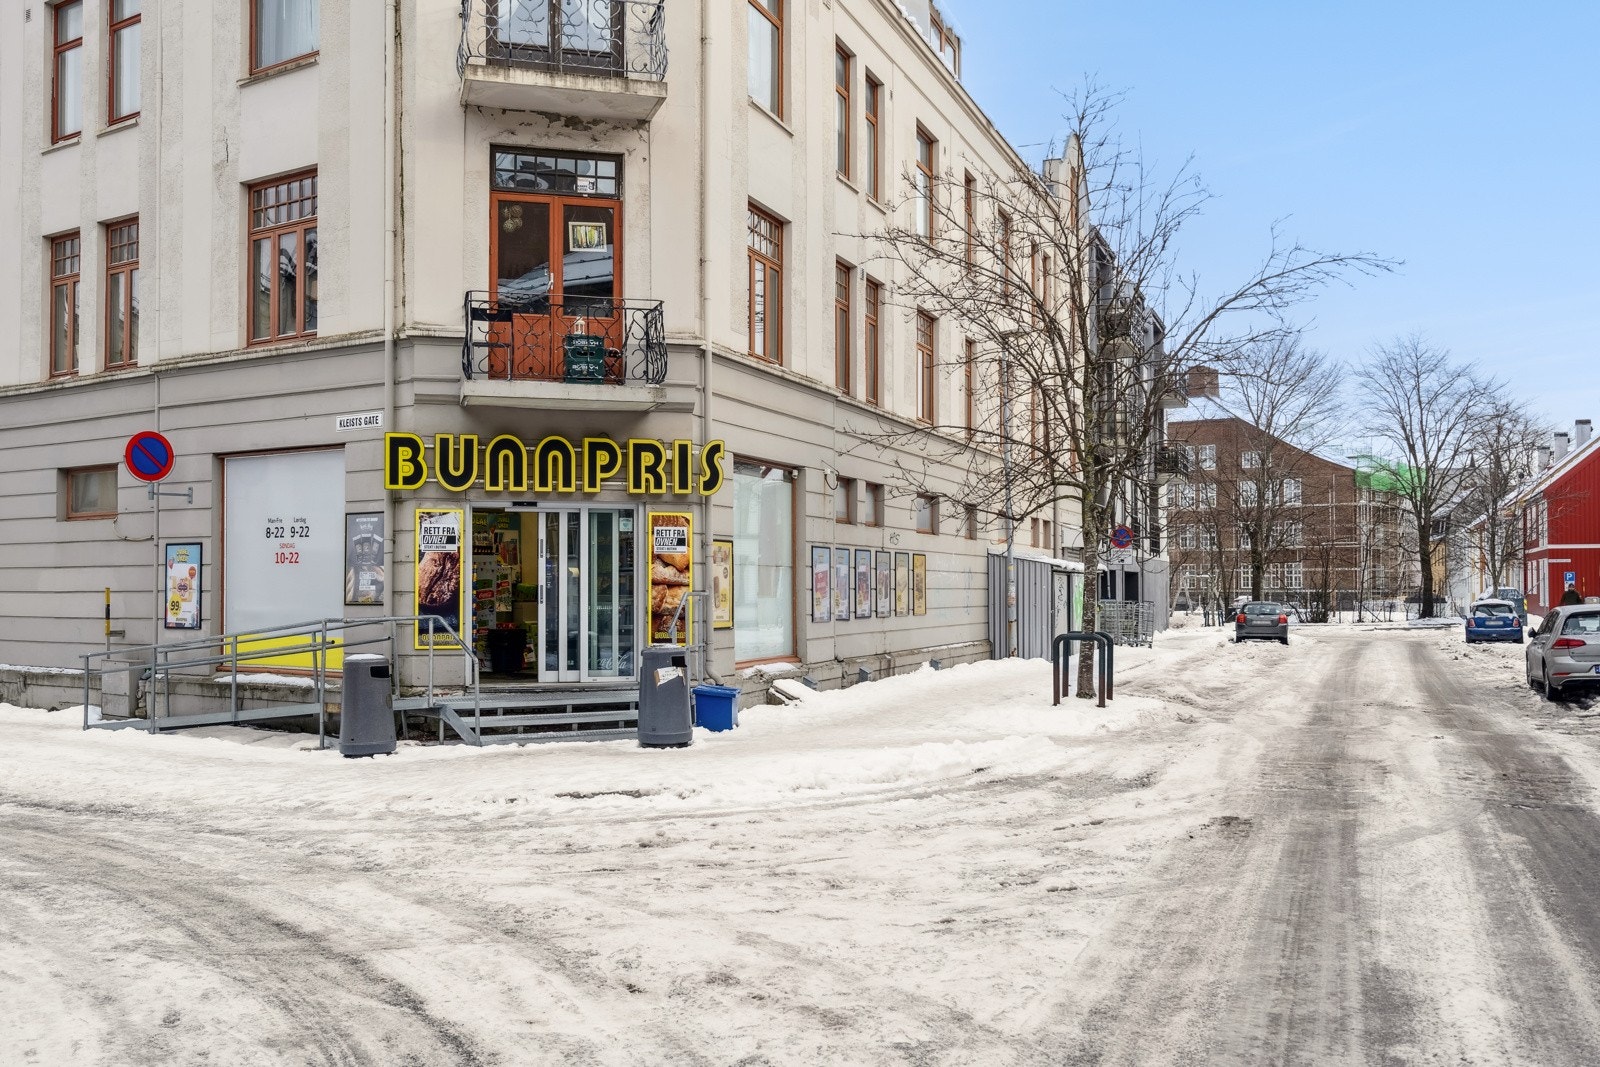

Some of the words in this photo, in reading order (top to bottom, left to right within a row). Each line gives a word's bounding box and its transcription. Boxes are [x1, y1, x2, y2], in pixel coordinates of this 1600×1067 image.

[339, 417, 362, 428] KLEISTS
[363, 415, 379, 426] GATE
[384, 432, 724, 496] BUNNPRIS
[265, 526, 285, 539] 8-22
[290, 525, 310, 538] 9-22
[423, 526, 440, 535] RETT
[442, 526, 456, 535] FRA
[655, 529, 671, 537] RETT
[672, 529, 686, 537] FRA
[423, 535, 448, 545] OVNEN
[655, 537, 678, 546] OVNEN
[275, 552, 299, 564] 10-22
